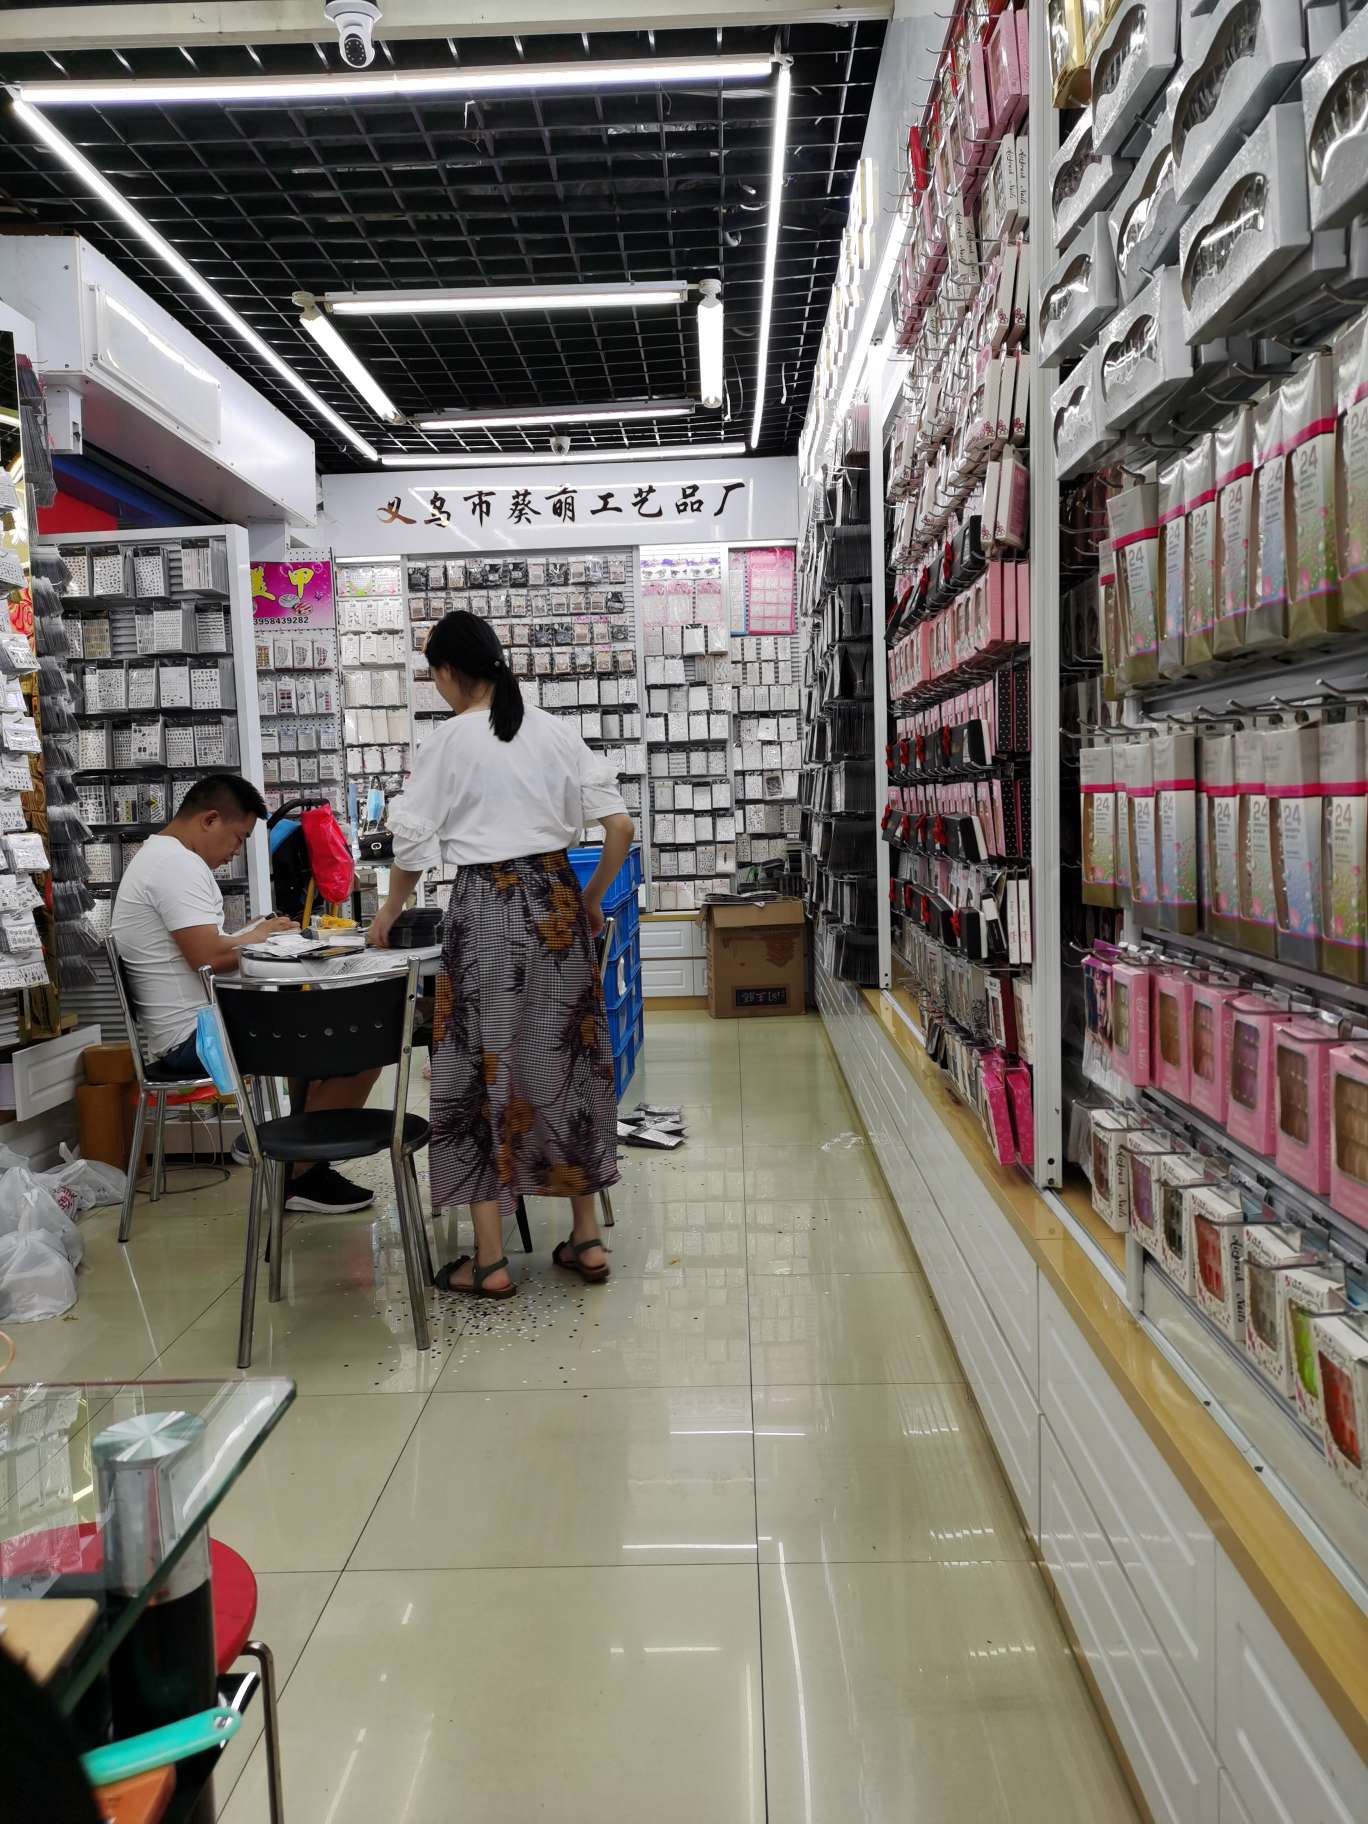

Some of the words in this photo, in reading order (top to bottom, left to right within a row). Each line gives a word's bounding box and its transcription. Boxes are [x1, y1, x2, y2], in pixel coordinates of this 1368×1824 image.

[1300, 444, 1317, 474] 24
[1228, 484, 1243, 510] 24
[1194, 510, 1209, 537] 24
[1128, 546, 1144, 566] 24
[1096, 797, 1110, 812] 24
[1216, 802, 1231, 821] 24
[1284, 804, 1302, 826] 24
[1336, 803, 1352, 827] 24
